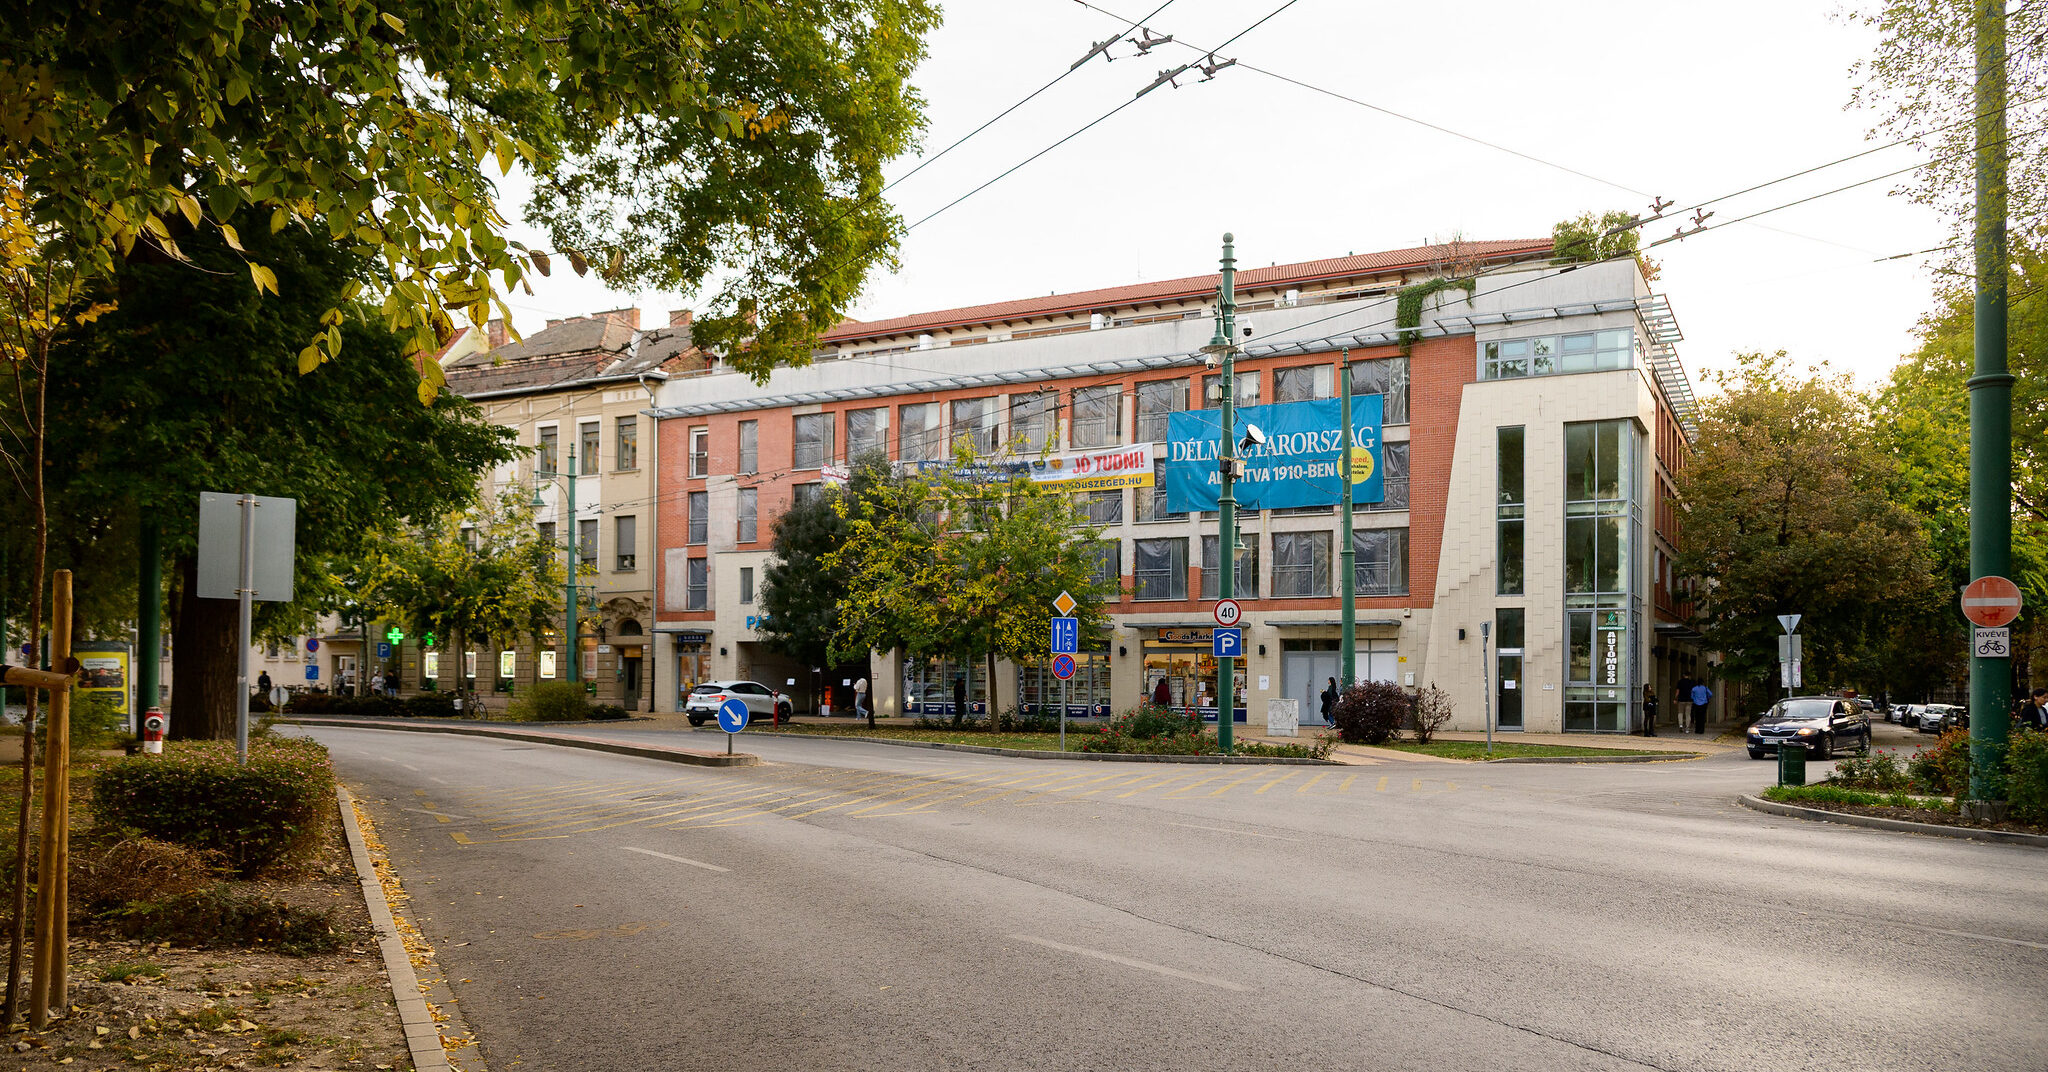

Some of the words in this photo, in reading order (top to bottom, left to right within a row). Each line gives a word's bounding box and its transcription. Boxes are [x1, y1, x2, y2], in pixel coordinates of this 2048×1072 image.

[1072, 453, 1091, 474] JÓ
[1094, 451, 1145, 471] TUDNI!
[1207, 467, 1270, 485] ALTVA
[1272, 462, 1335, 481] 1910-BEN
[1221, 607, 1235, 618] 40
[1976, 630, 2008, 638] KIVÉVE
[1221, 637, 1235, 654] P
